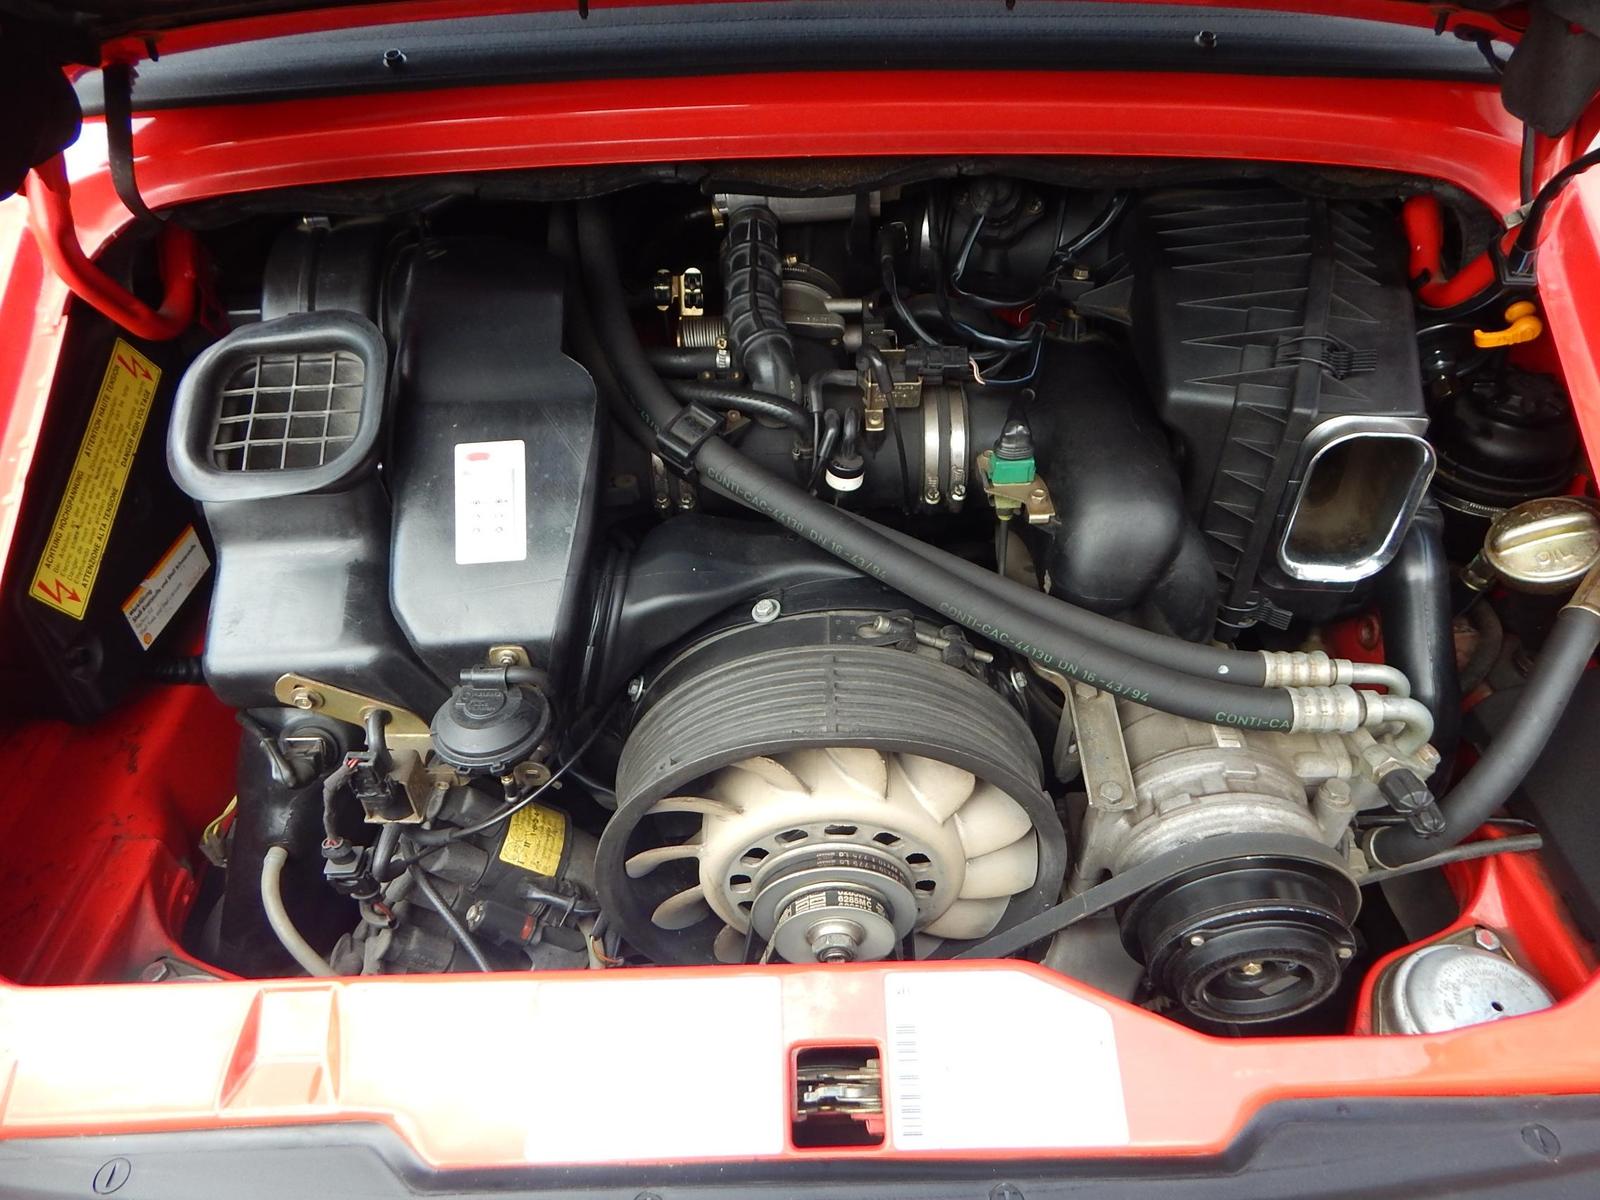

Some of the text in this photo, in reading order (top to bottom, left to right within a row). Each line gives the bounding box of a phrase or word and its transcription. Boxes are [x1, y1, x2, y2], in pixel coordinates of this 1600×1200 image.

[84, 417, 101, 457] ATTENTION
[97, 393, 109, 417] HAUTE
[106, 364, 120, 392] TENSION
[120, 437, 134, 468] DANGER
[130, 419, 140, 438] HIGH
[136, 388, 149, 420] VOLTAGE
[44, 531, 62, 569] ACHTUNG
[58, 469, 83, 531] HOCHSPANNUNG
[81, 542, 100, 588] ATTENZIONE
[96, 521, 106, 541] ALTA
[103, 486, 117, 521] TENSIONE
[808, 527, 827, 545] DN
